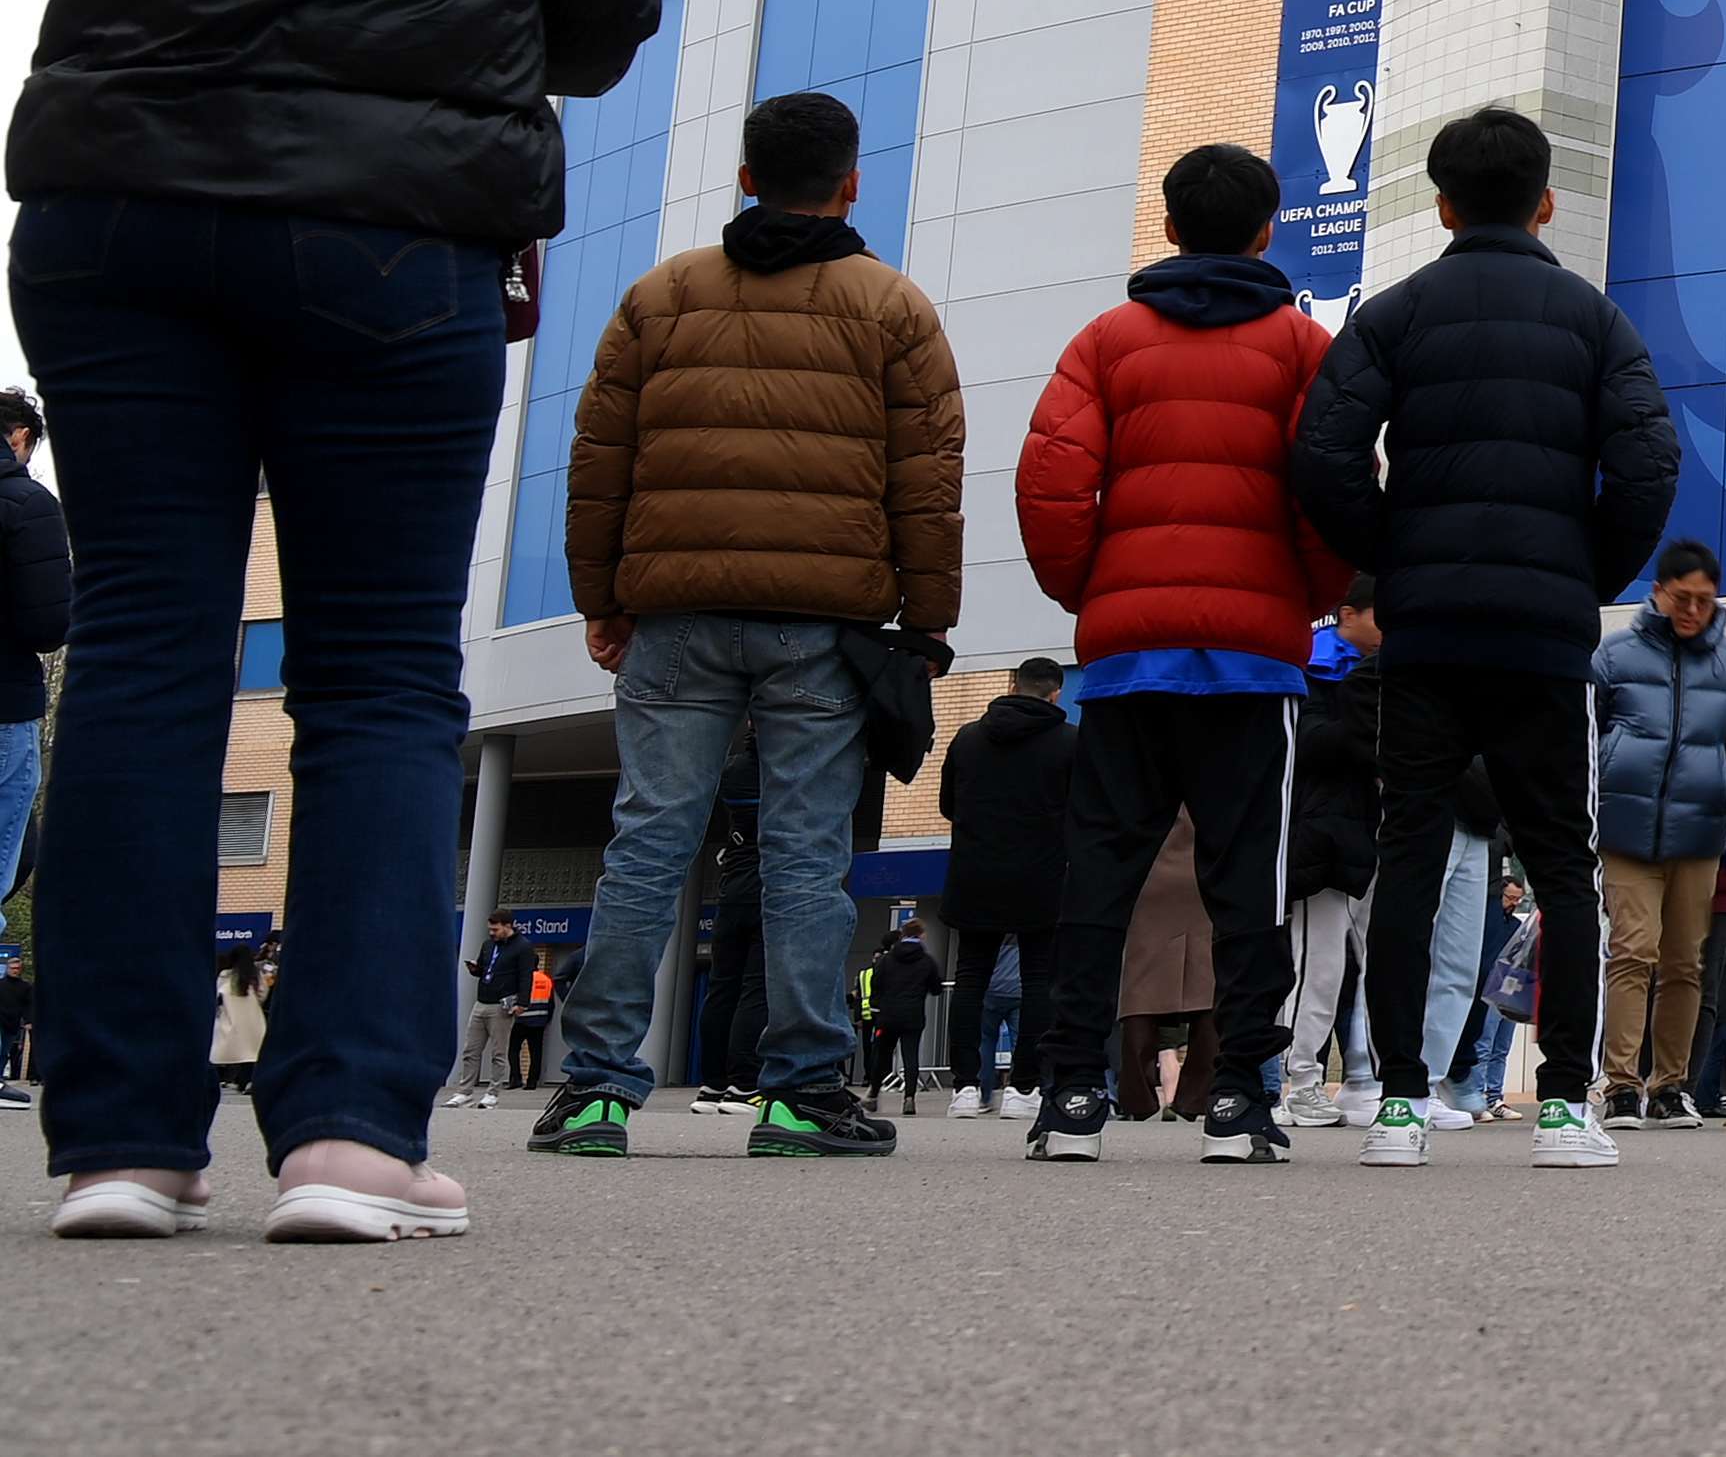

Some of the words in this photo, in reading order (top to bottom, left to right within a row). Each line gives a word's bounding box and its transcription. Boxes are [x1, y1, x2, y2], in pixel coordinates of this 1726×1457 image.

[1328, 4, 1345, 18] FA
[1347, 0, 1375, 14] CUP
[1280, 207, 1313, 223] UEFA
[1316, 199, 1368, 217] CHAMPI
[1311, 219, 1362, 237] LEAGUE
[1311, 244, 1335, 256] 2012,
[1337, 241, 1359, 252] 2021
[513, 919, 531, 934] est
[535, 919, 569, 934] Stand
